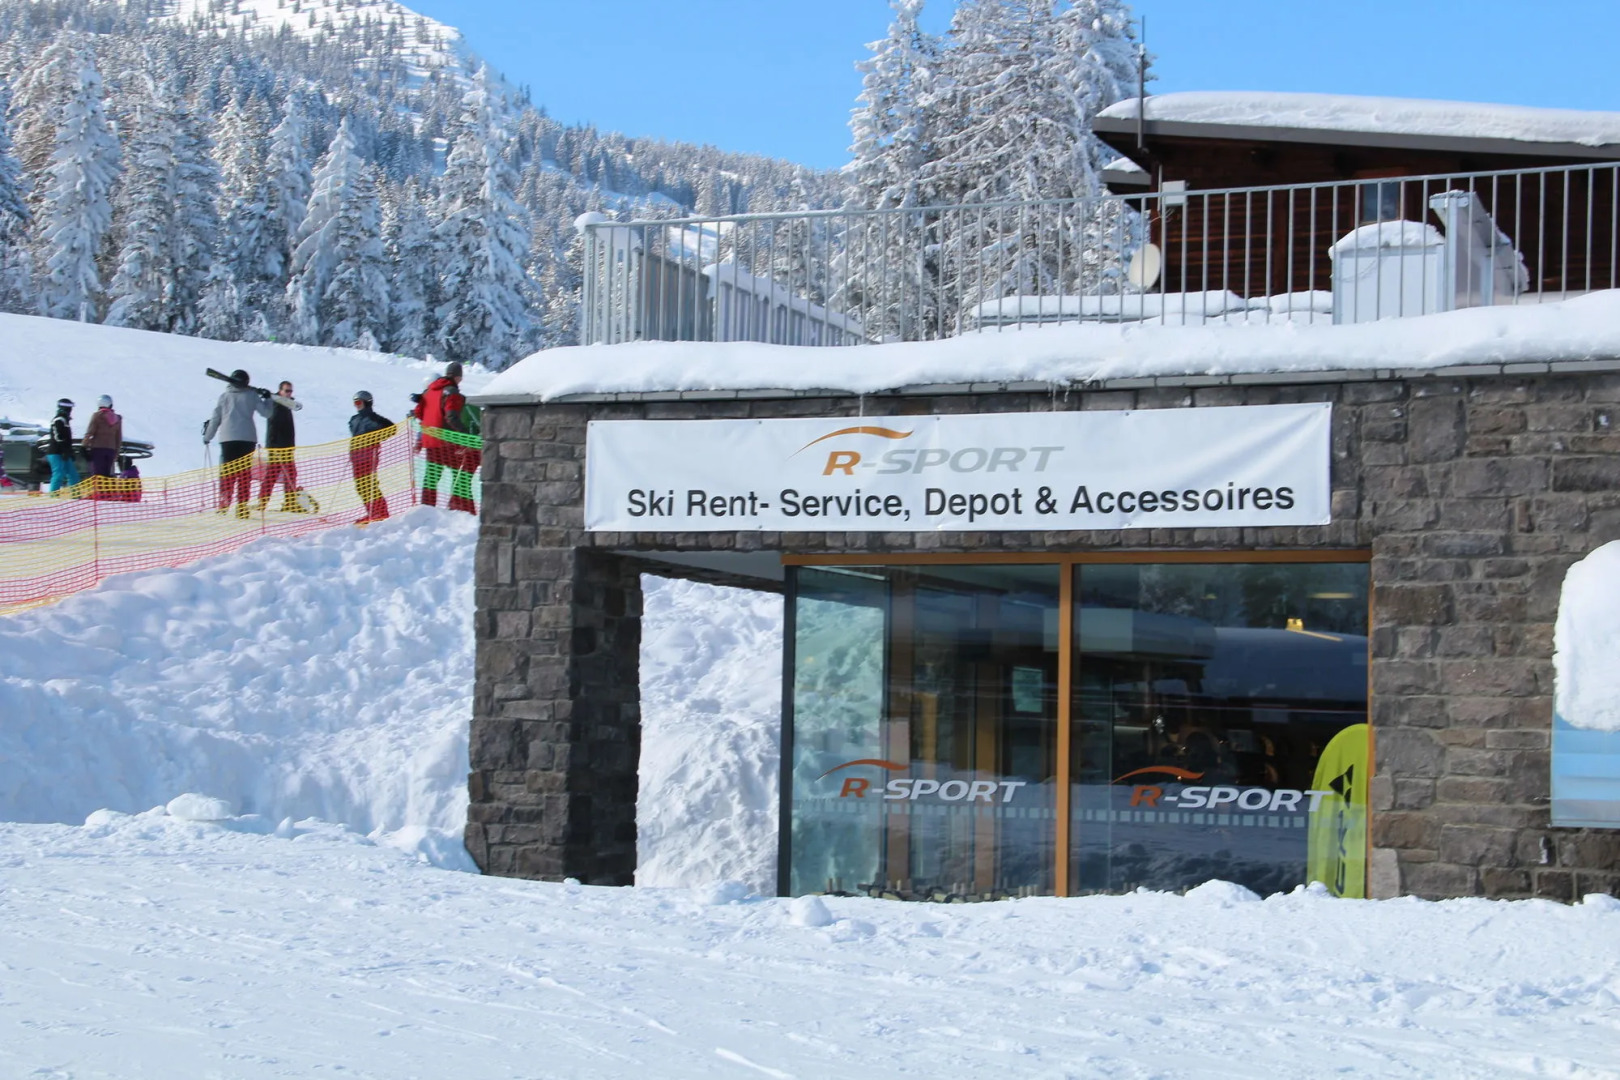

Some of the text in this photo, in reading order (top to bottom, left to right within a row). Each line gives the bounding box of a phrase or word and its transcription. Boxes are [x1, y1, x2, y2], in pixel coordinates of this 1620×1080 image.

[822, 446, 1065, 476] R-SPORT
[627, 481, 1294, 522] Ski Rent- Service, Depot & Accessoires
[840, 777, 1026, 803] R-SPORT
[1129, 785, 1335, 813] R-SPORT
